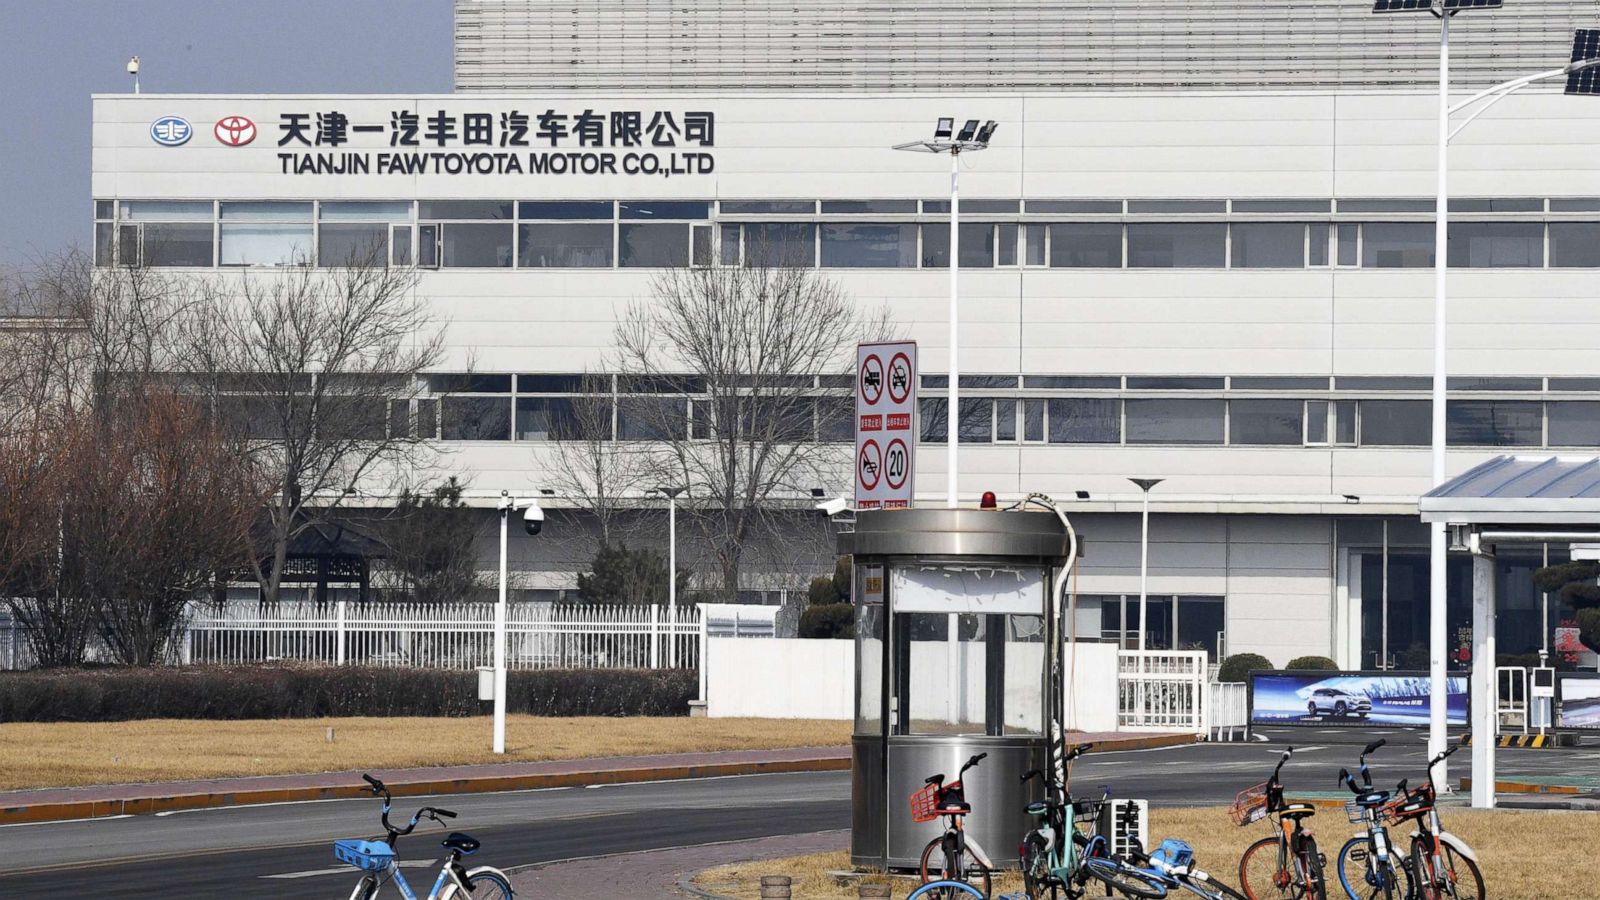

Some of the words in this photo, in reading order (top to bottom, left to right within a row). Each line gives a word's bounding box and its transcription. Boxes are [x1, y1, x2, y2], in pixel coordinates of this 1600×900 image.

[278, 110, 715, 148] 天津一汽丰田汽车有限公司
[277, 153, 369, 175] TIANJIN
[529, 153, 617, 175] MOTOR
[889, 450, 903, 477] 20
